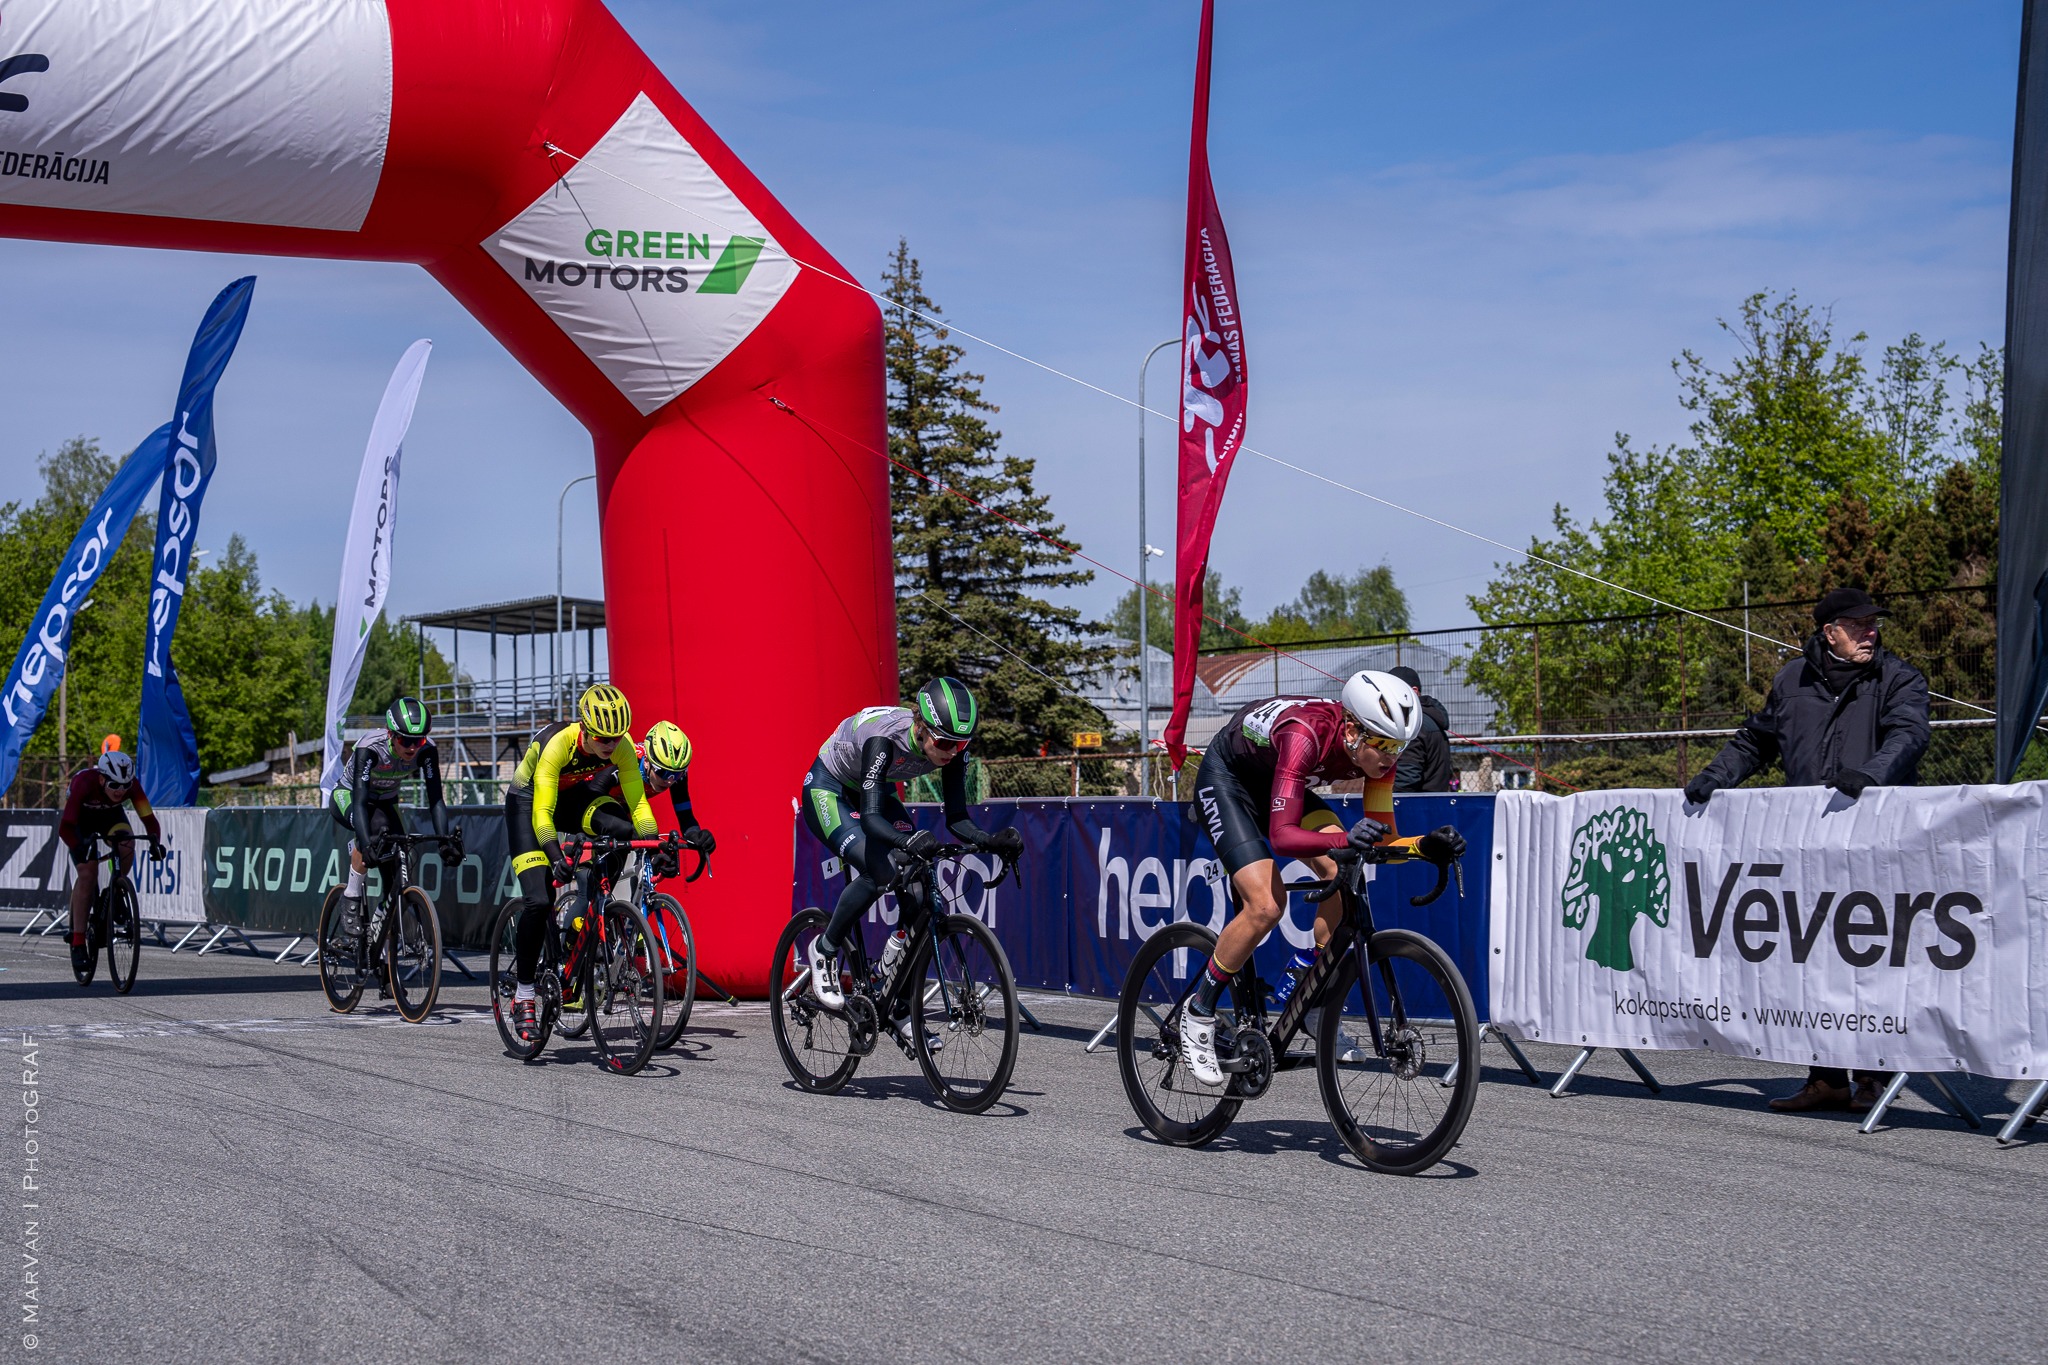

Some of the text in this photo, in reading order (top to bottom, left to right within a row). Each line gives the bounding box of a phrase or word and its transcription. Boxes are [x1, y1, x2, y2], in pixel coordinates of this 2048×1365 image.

[585, 229, 710, 260] GREEN
[525, 257, 689, 294] MOTORS
[1198, 786, 1224, 846] LATVIA
[827, 862, 833, 873] 4
[1205, 862, 1219, 880] 24
[1684, 861, 1983, 971] Vēvers
[1614, 990, 1908, 1035] kokapstrāde www.vevers.eu
